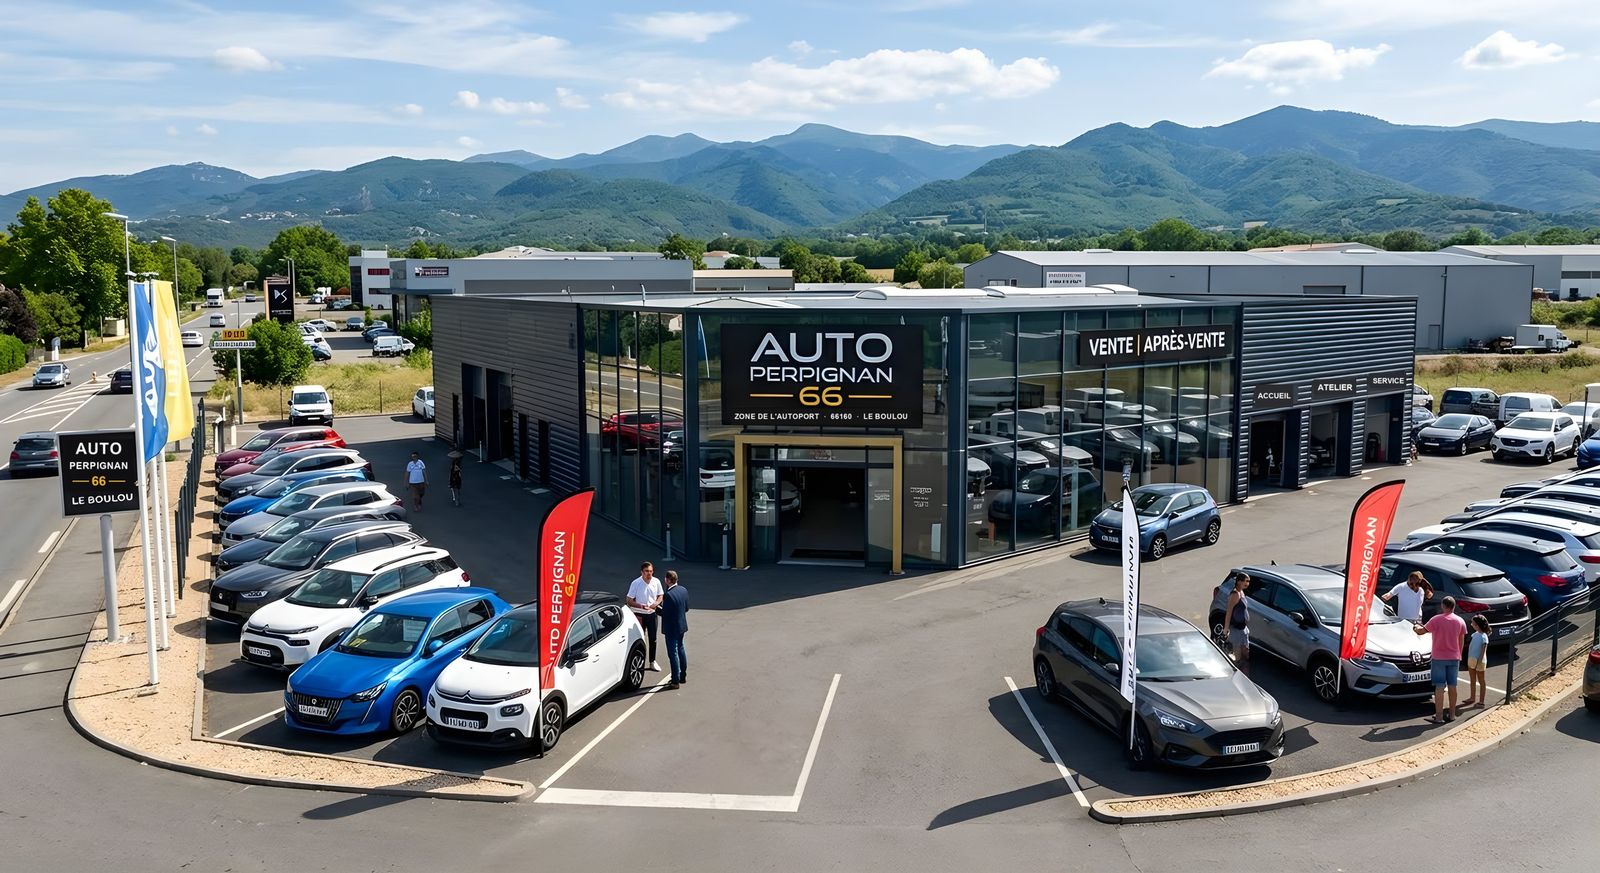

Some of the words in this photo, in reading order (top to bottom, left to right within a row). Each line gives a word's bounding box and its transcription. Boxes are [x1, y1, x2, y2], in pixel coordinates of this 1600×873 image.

[750, 332, 893, 363] AUTO
[1089, 336, 1134, 357] VENTE
[1144, 329, 1225, 353] APRÈS-VENTE
[750, 366, 893, 383] PERPIGNAN
[1317, 383, 1353, 391] ATELIER
[1372, 377, 1405, 385] SERVICE
[799, 386, 843, 407] 66
[1257, 392, 1291, 400] ACCUEIL
[75, 442, 122, 455] AUTO
[69, 461, 128, 470] PERPIGNAN
[91, 476, 106, 486] 66
[72, 496, 85, 505] LE
[88, 493, 133, 504] BOULOU
